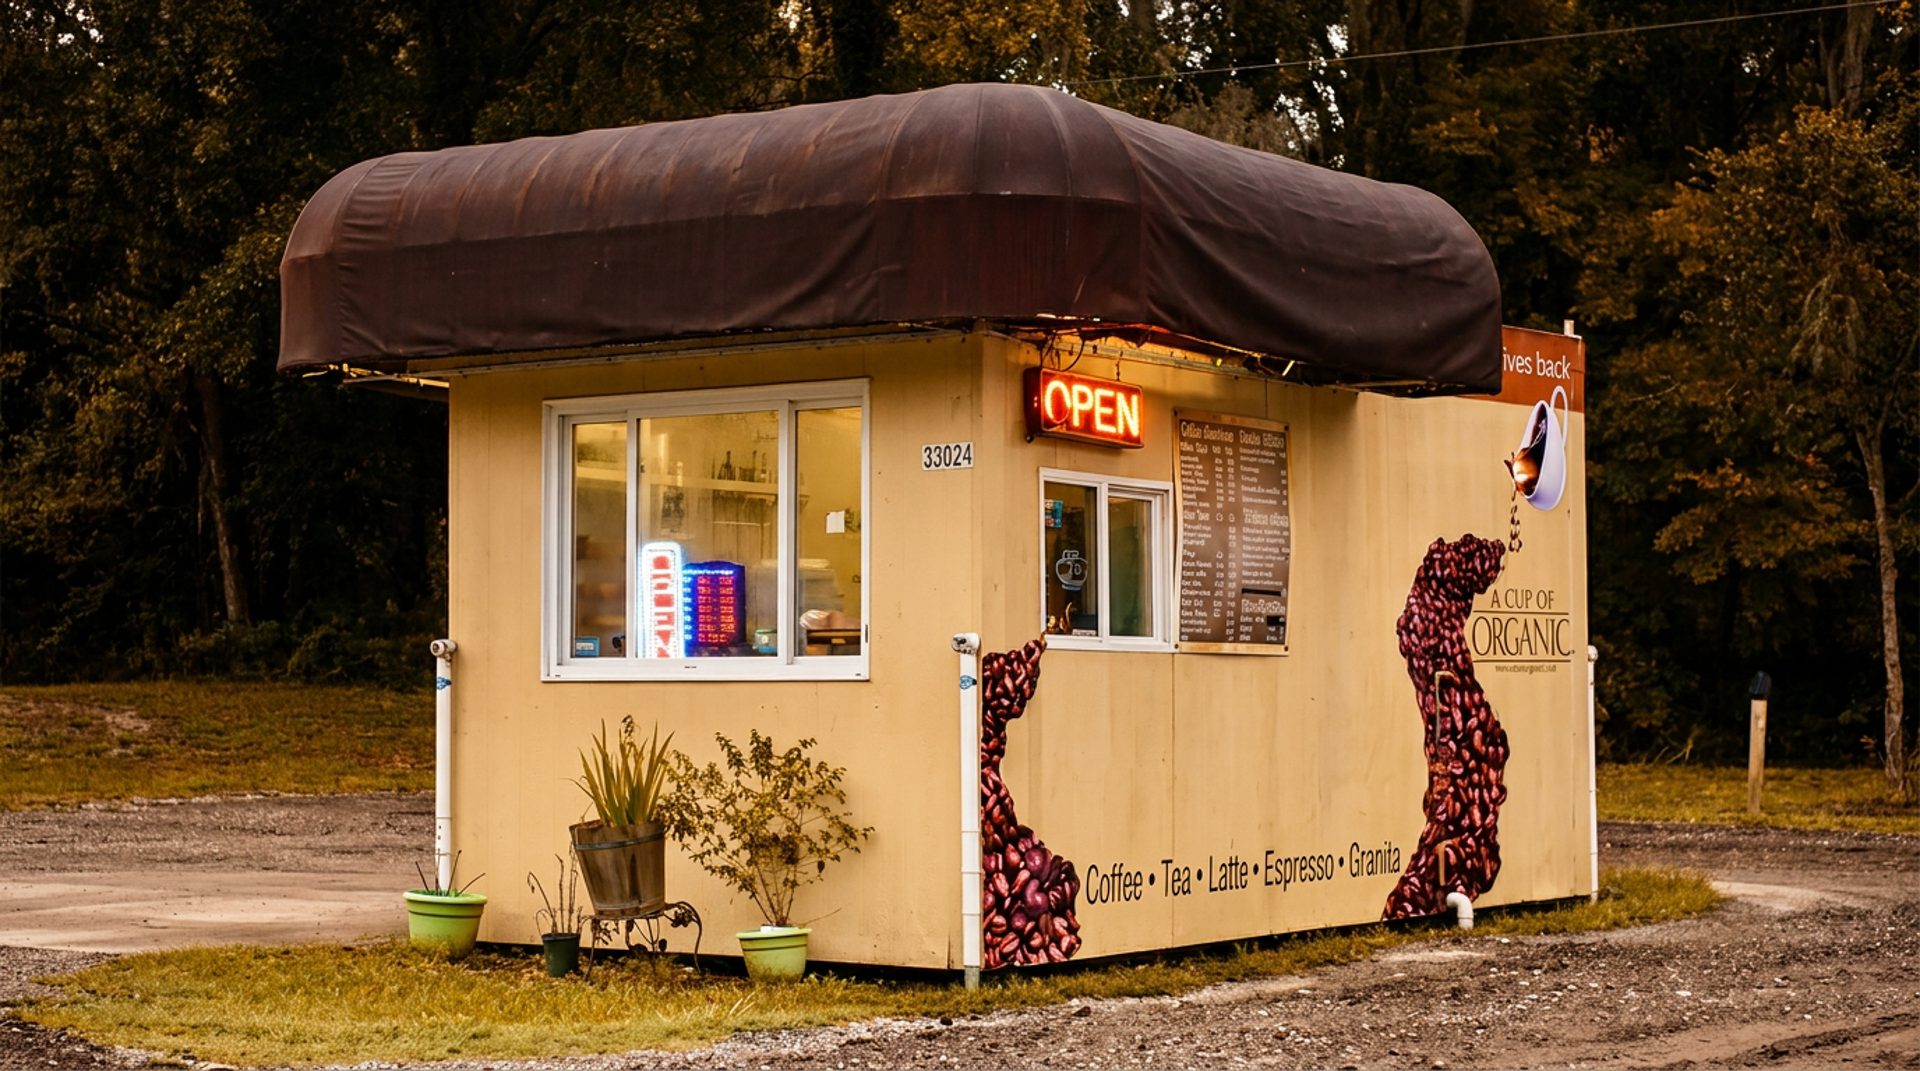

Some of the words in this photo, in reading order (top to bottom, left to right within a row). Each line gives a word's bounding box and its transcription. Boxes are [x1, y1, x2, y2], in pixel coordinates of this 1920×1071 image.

[1503, 346, 1532, 374] ives
[1536, 351, 1571, 379] back
[1045, 380, 1139, 437] OPEN
[923, 443, 972, 468] 33024
[1491, 589, 1501, 608] A
[1505, 589, 1533, 609] CUP
[1536, 590, 1554, 609] OF
[1472, 616, 1571, 656] ORGANIC
[1086, 862, 1143, 905] Coffee
[1161, 859, 1191, 897] Tea
[1209, 855, 1248, 893] Latte
[1264, 850, 1334, 892] Espresso
[1349, 841, 1401, 878] Granita
